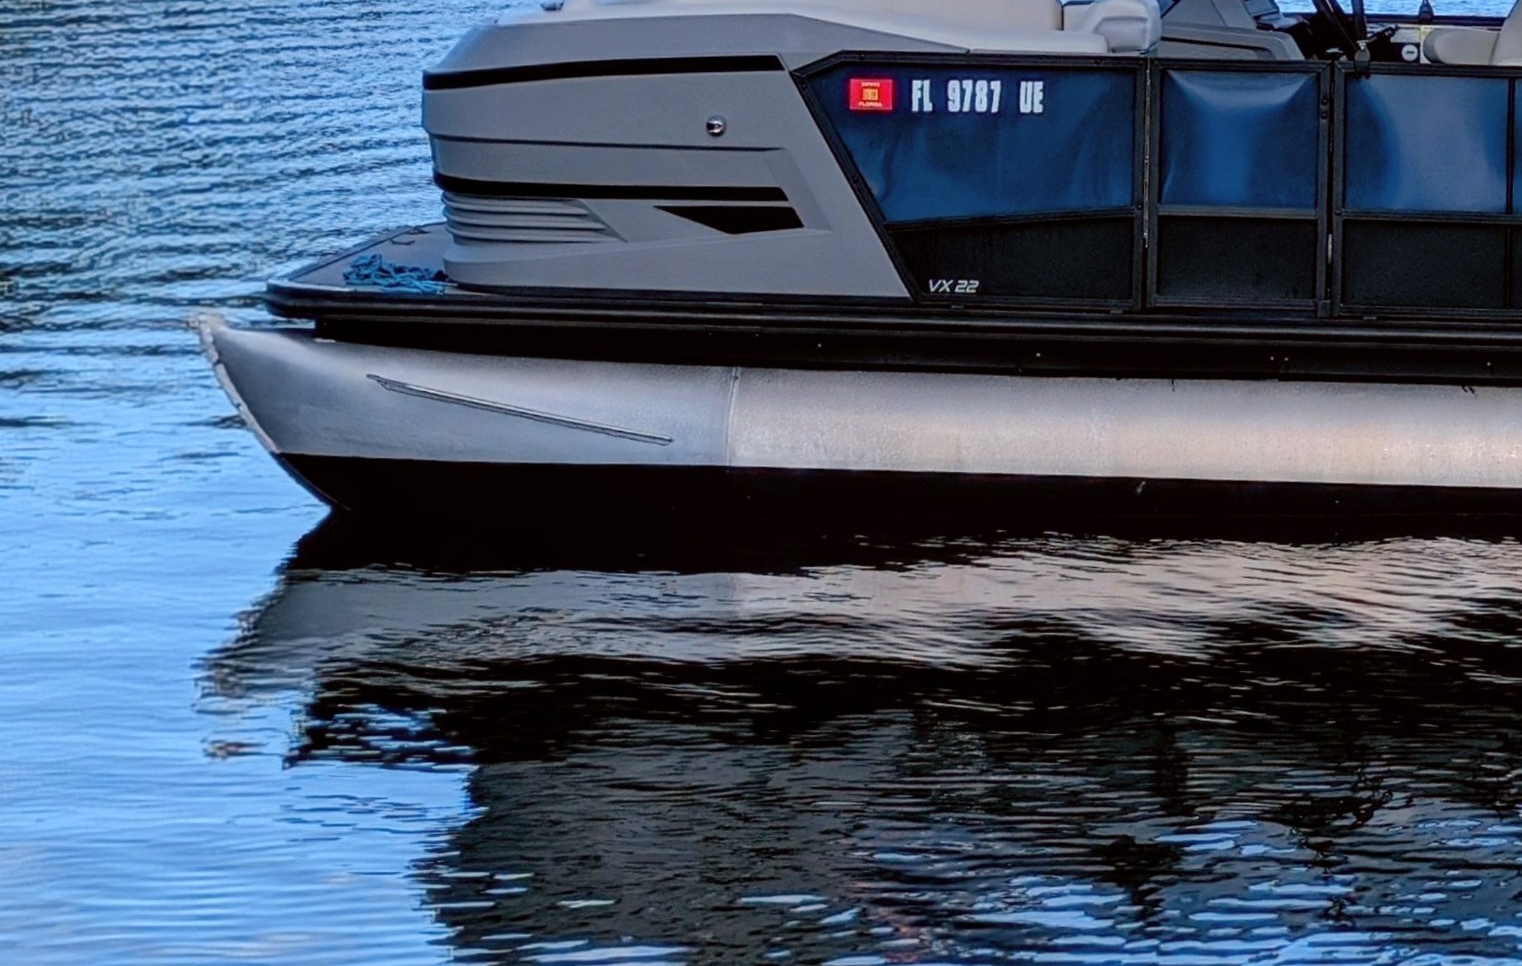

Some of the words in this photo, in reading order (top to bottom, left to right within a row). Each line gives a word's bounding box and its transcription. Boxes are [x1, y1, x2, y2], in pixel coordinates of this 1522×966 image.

[911, 79, 933, 112] FL
[947, 79, 1001, 113] 9787
[1019, 81, 1044, 114] UE
[928, 279, 954, 293] VX
[954, 279, 980, 293] 22
